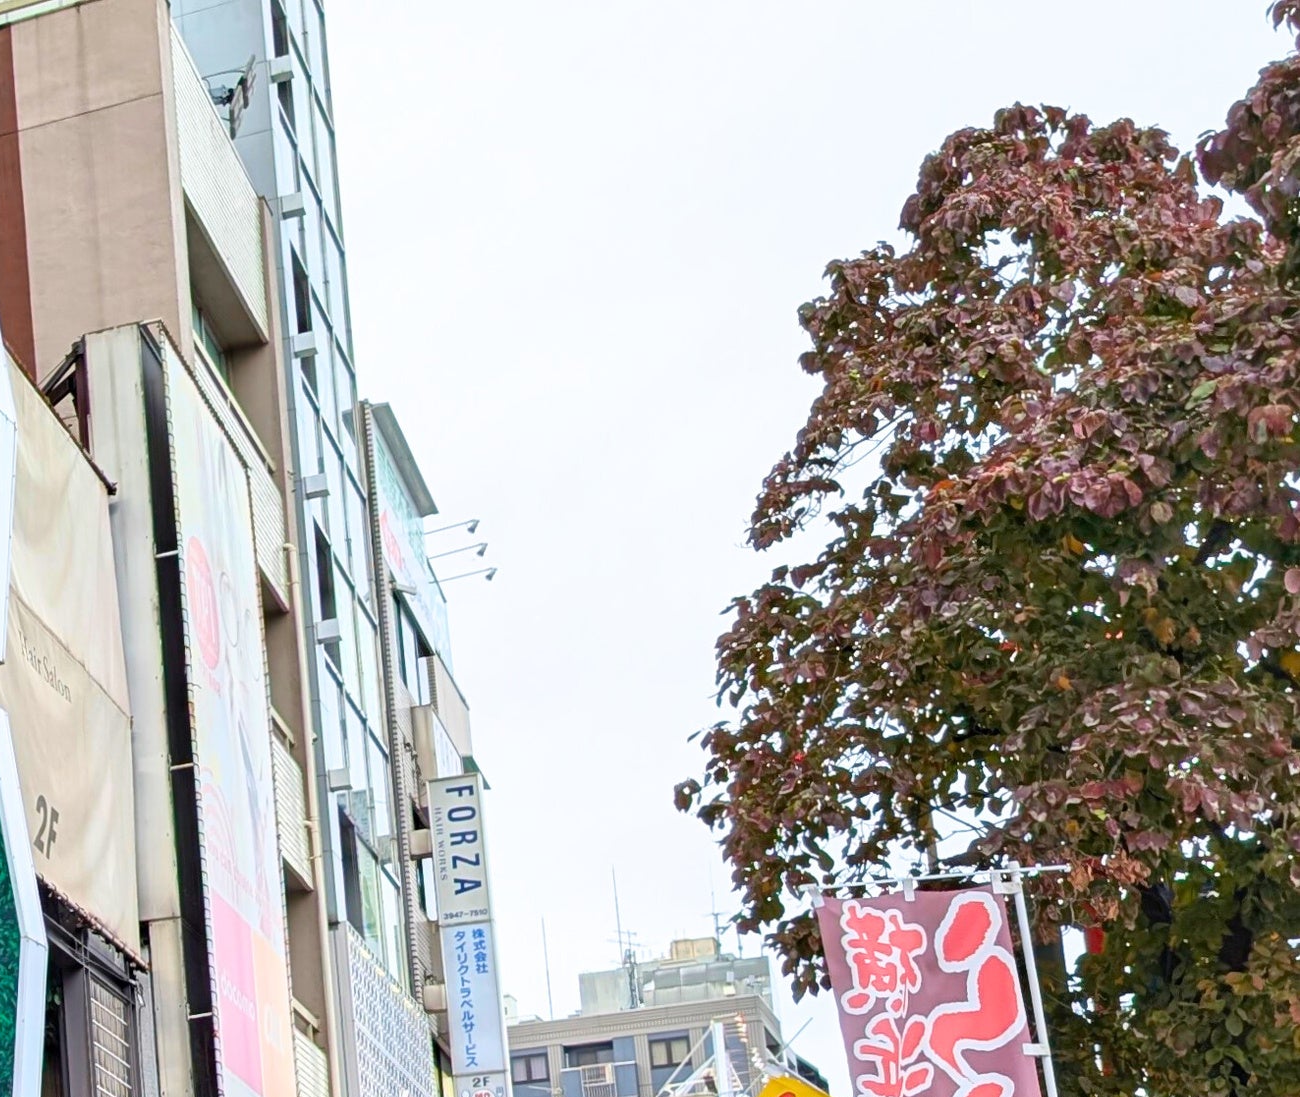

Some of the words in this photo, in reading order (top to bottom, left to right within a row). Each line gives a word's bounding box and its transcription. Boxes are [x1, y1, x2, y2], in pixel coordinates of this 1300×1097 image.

[42, 655, 73, 704] Salon
[33, 793, 60, 861] 2F
[434, 807, 442, 838] HAIR
[438, 839, 448, 881] WORKS
[445, 784, 483, 896] FORZA
[472, 928, 489, 974] 株式会社
[220, 967, 255, 1021] docomo
[454, 930, 479, 1068] タイリクトラベルサービス
[472, 1076, 491, 1088] 2F
